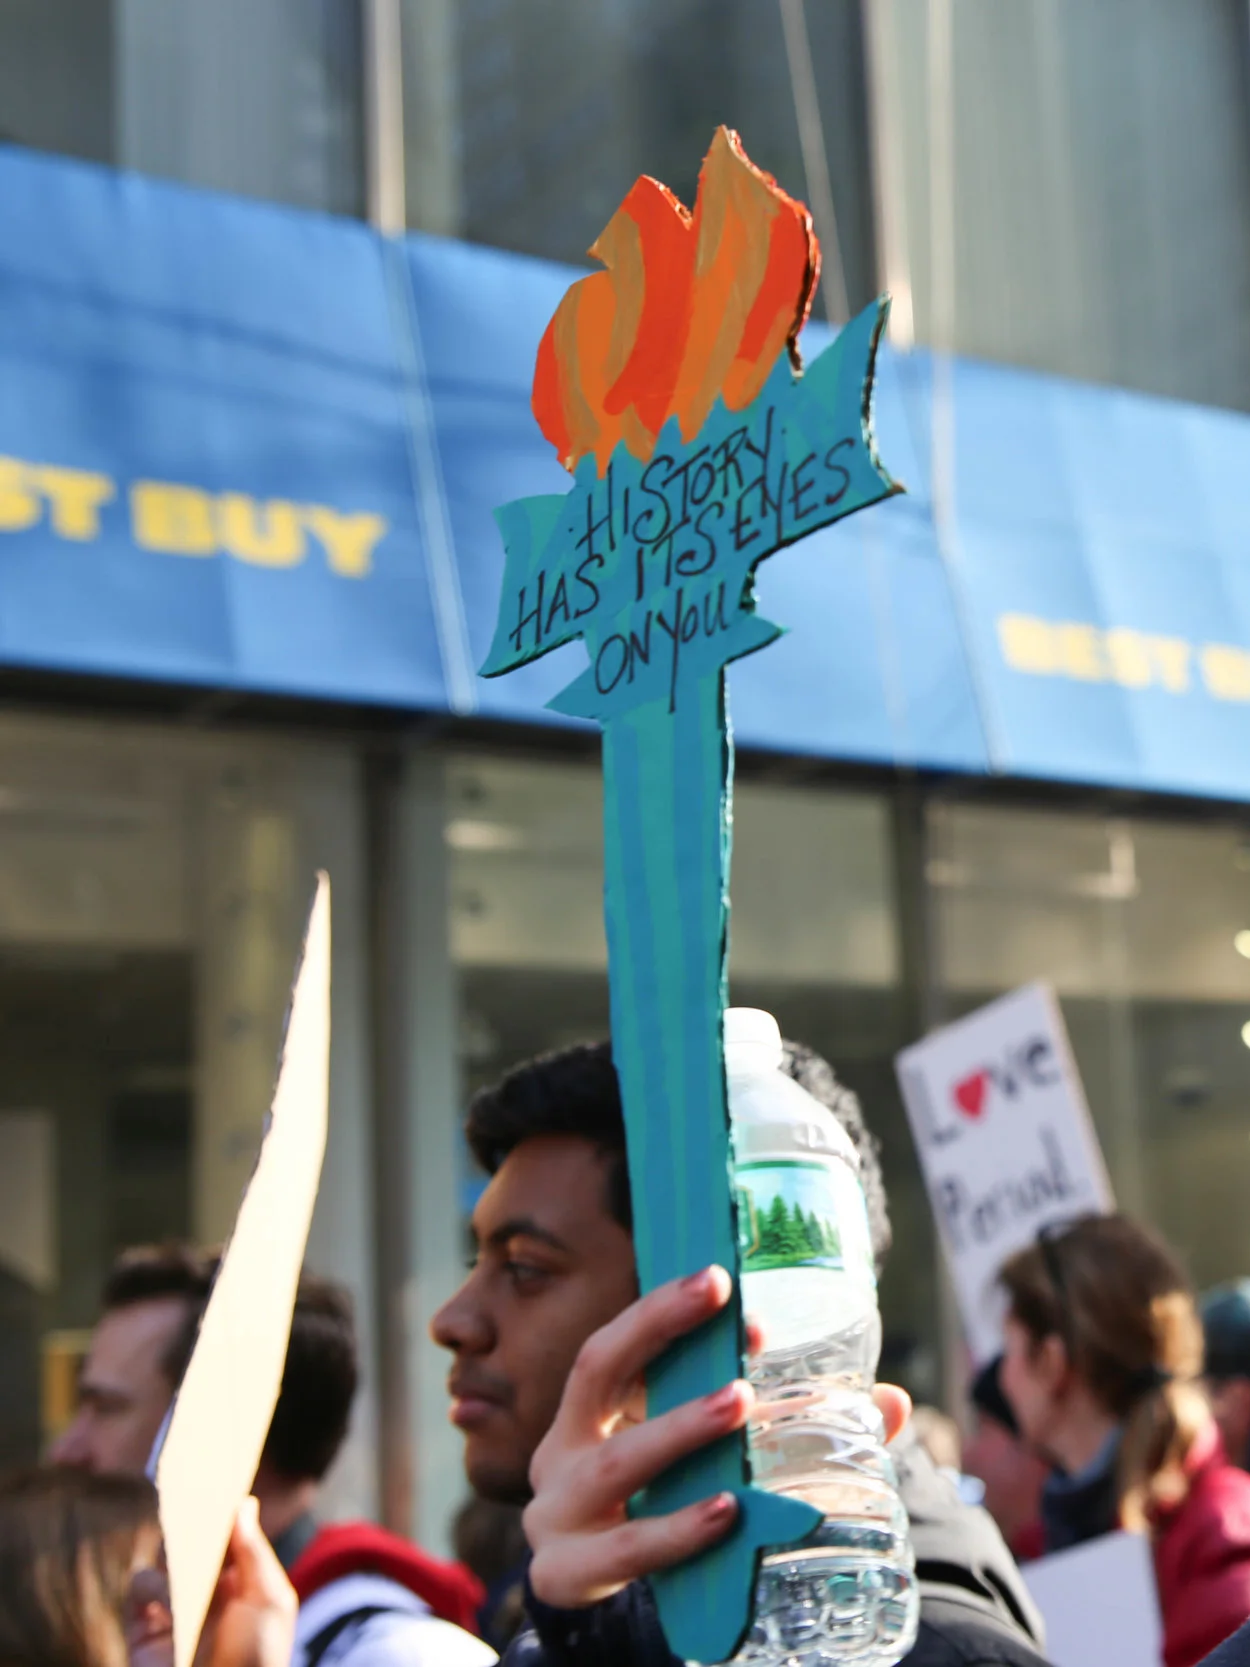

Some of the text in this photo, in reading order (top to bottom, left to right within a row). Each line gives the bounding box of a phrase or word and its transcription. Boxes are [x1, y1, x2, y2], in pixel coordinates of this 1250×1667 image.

[129, 477, 389, 579] BUY
[576, 406, 774, 557] HISTORY
[509, 437, 856, 651] HAS ITS EYES
[595, 610, 653, 695] ON
[998, 612, 1191, 694] BEST
